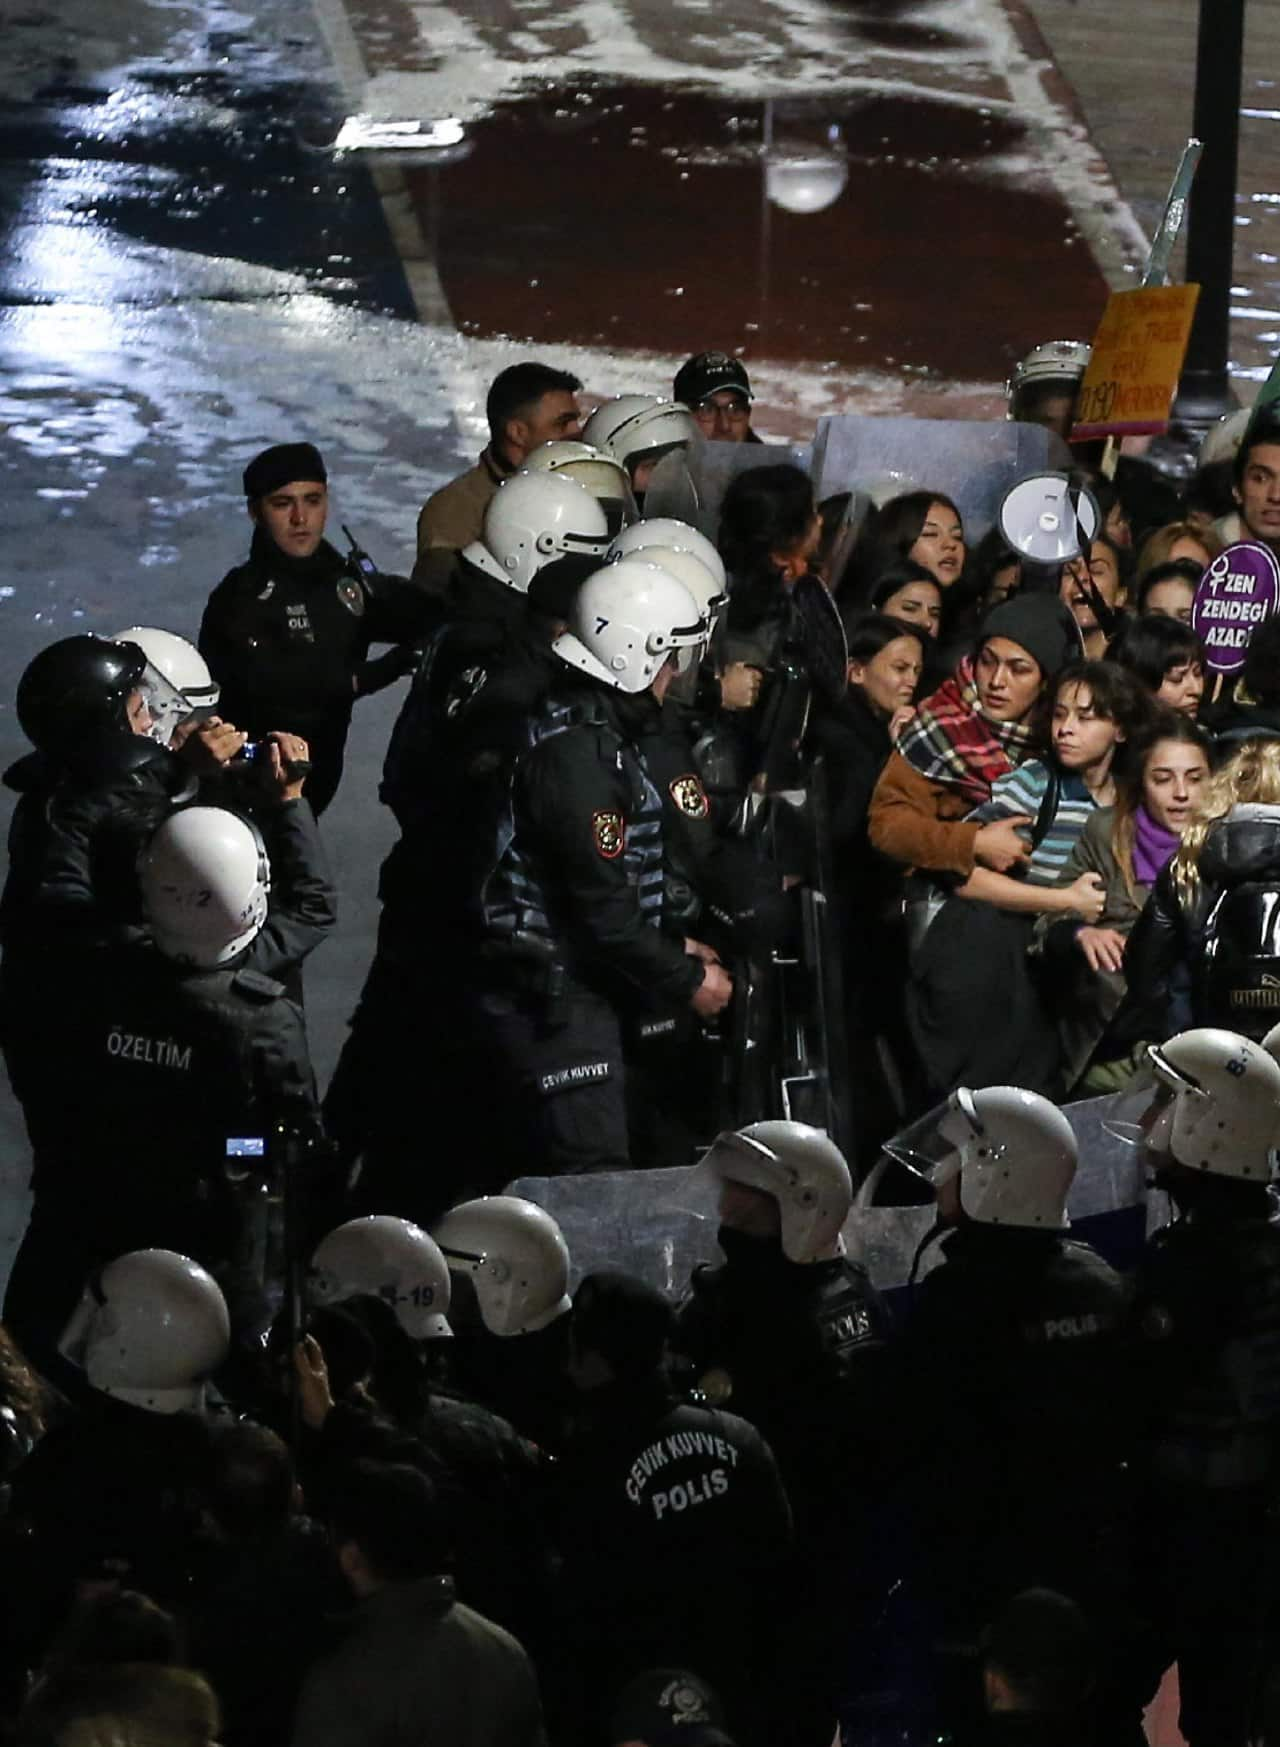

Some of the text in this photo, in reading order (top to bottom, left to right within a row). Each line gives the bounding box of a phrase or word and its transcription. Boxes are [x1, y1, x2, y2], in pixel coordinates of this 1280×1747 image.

[1224, 573, 1256, 594] ZEN
[1201, 598, 1269, 622] ZENDEGİ
[596, 617, 609, 634] 7
[664, 1431, 738, 1469] KUVVET
